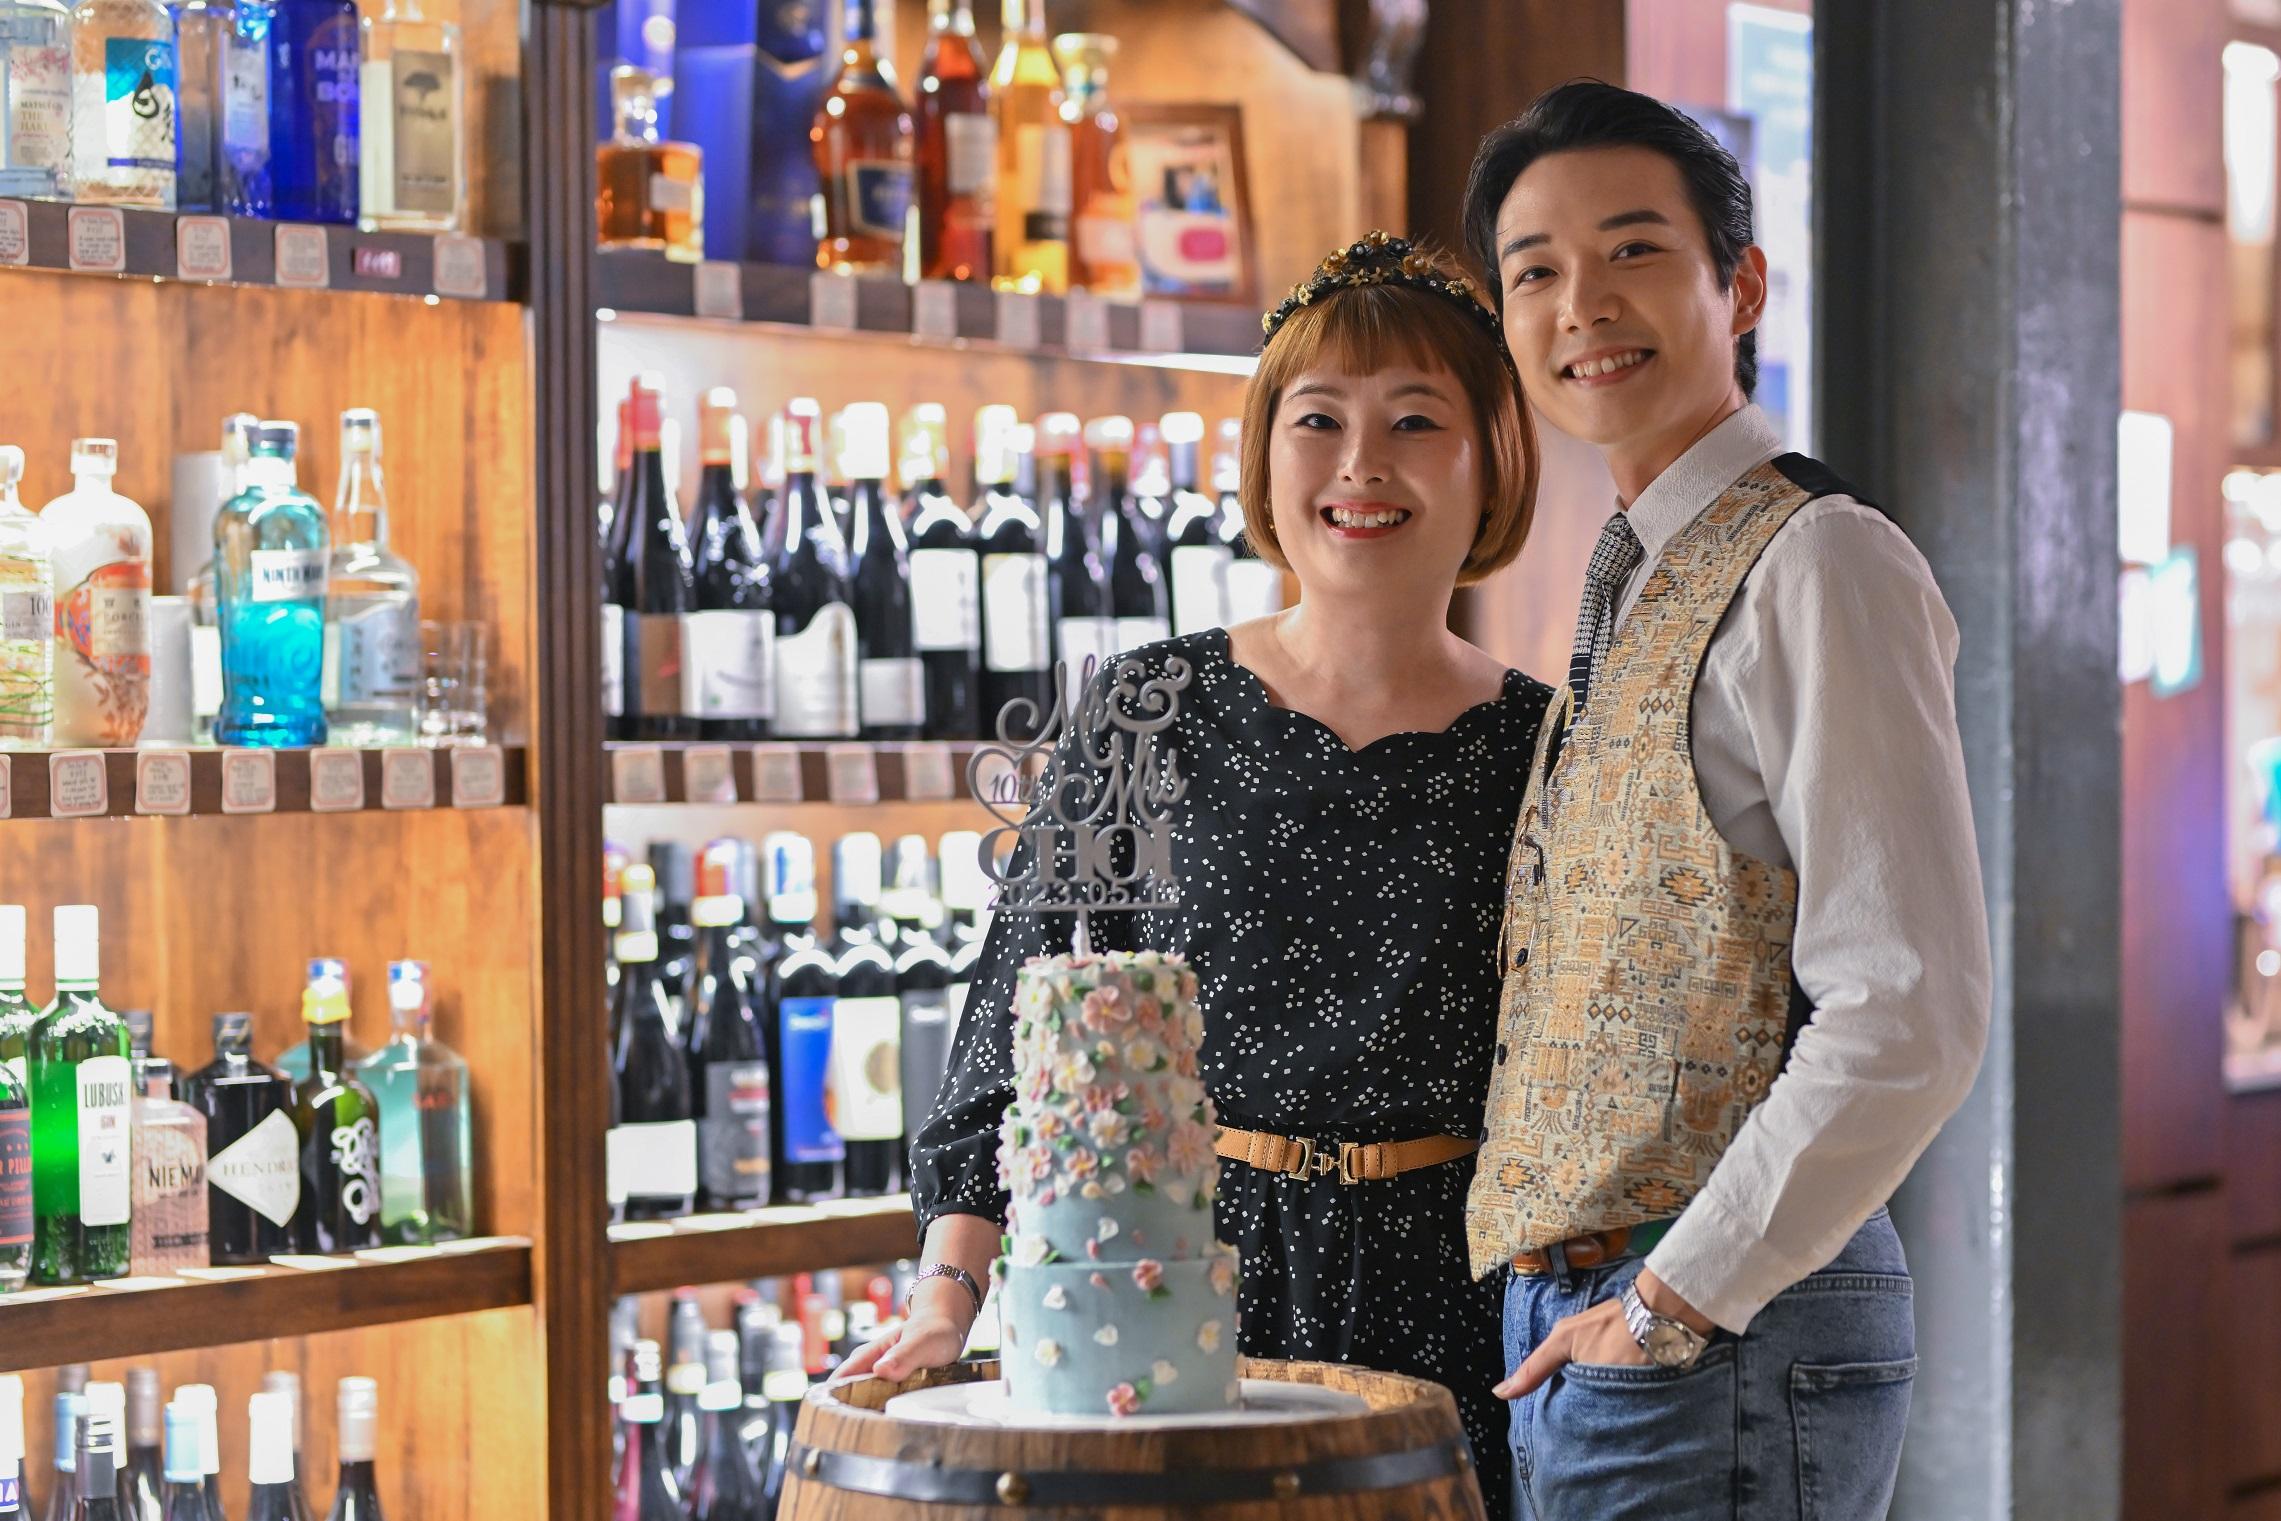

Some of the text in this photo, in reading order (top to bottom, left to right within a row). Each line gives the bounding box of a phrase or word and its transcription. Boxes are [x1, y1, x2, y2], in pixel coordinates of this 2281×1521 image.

[1109, 656, 1192, 734] &
[1052, 730, 1189, 828] Mrs
[977, 823, 1179, 885] CHOI
